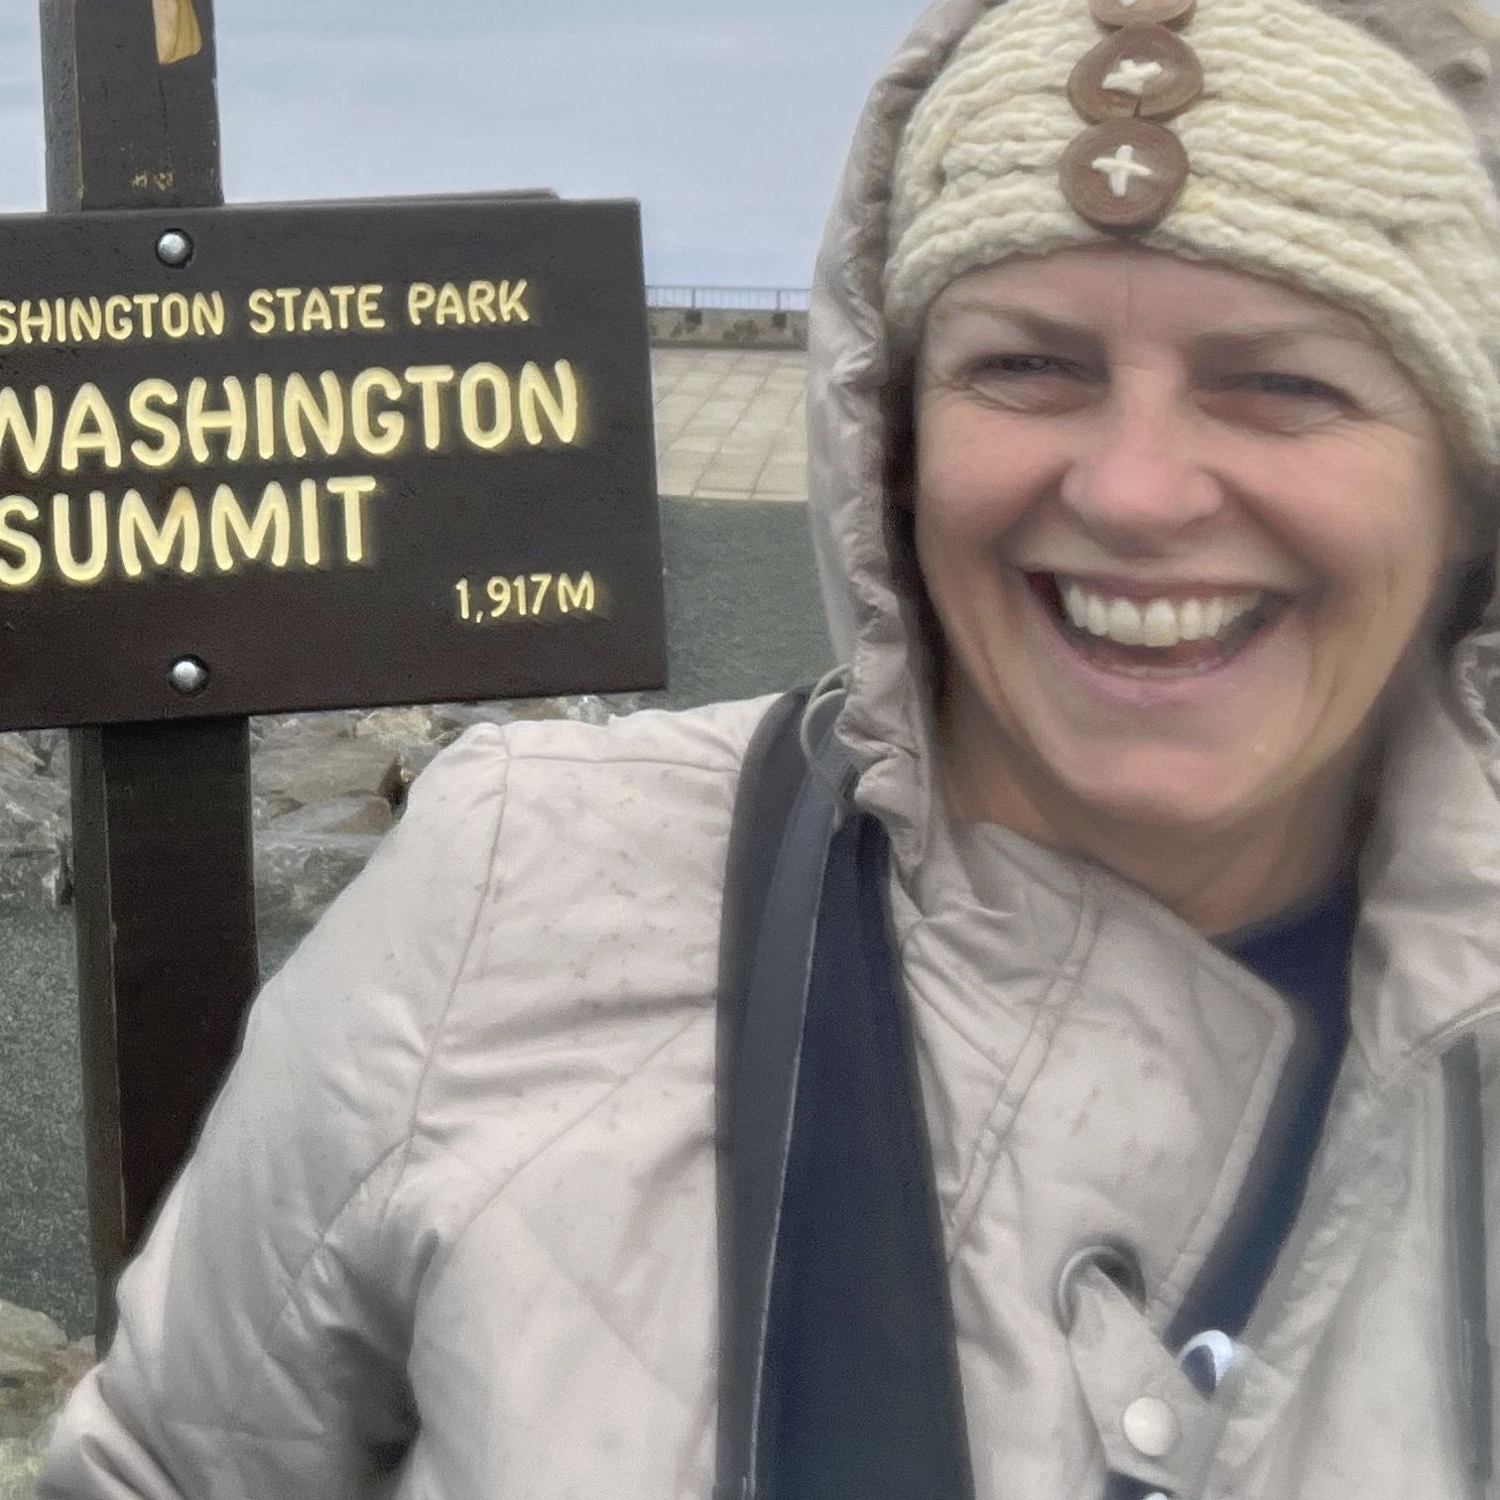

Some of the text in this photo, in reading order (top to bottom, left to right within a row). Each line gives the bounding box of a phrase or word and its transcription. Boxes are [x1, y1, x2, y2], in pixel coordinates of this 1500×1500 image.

[248, 284, 386, 335] STATE
[407, 279, 531, 327] PARK
[455, 571, 596, 624] 1,917M
